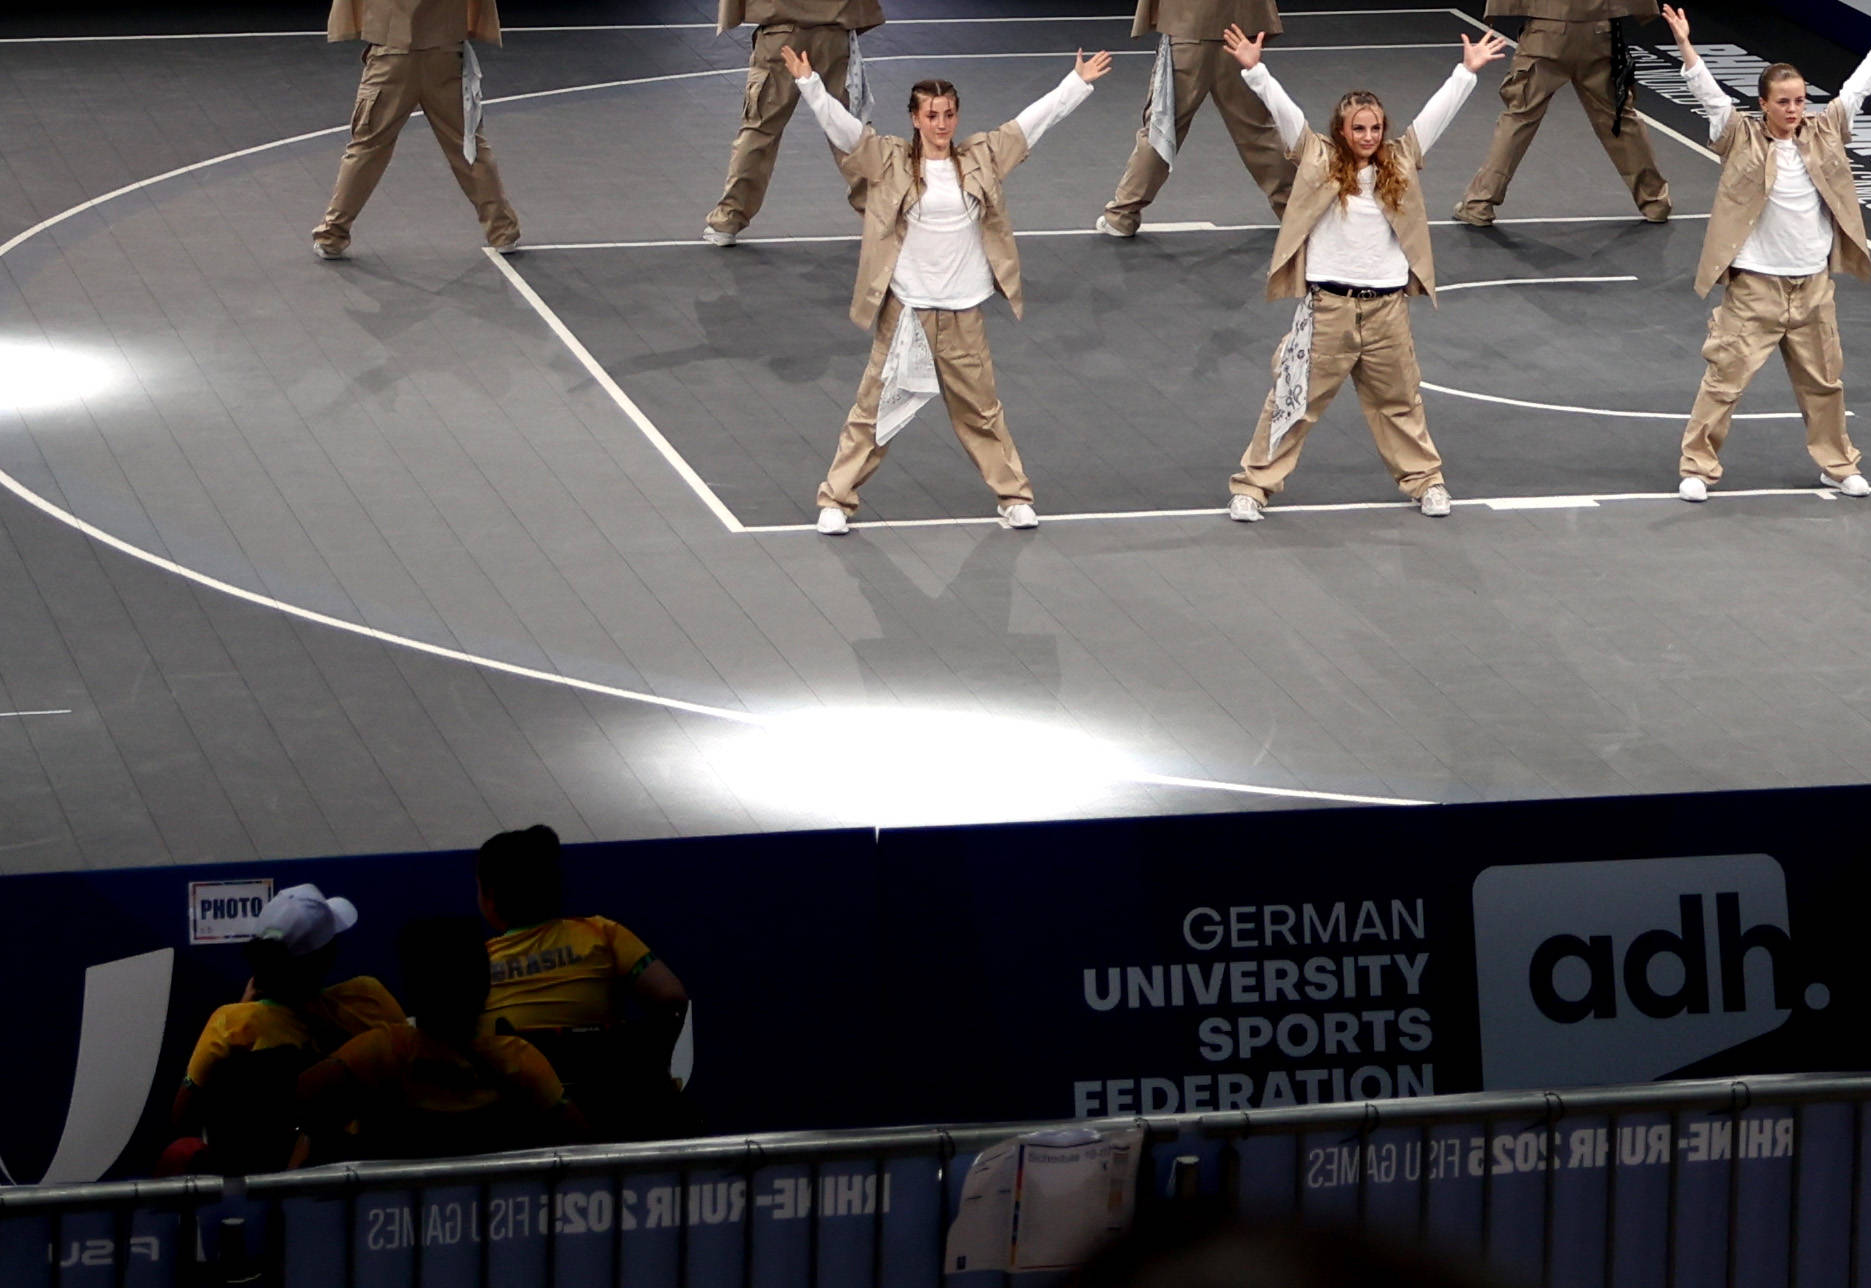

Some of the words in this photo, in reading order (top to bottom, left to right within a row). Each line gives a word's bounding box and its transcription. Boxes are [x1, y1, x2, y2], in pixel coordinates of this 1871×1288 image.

[200, 897, 262, 921] PHOTO
[1182, 897, 1427, 951] GERMAN
[1081, 952, 1431, 1012] UNIVERSITY
[1197, 1007, 1434, 1062] SPORTS
[1072, 1062, 1435, 1121] FEDERATION
